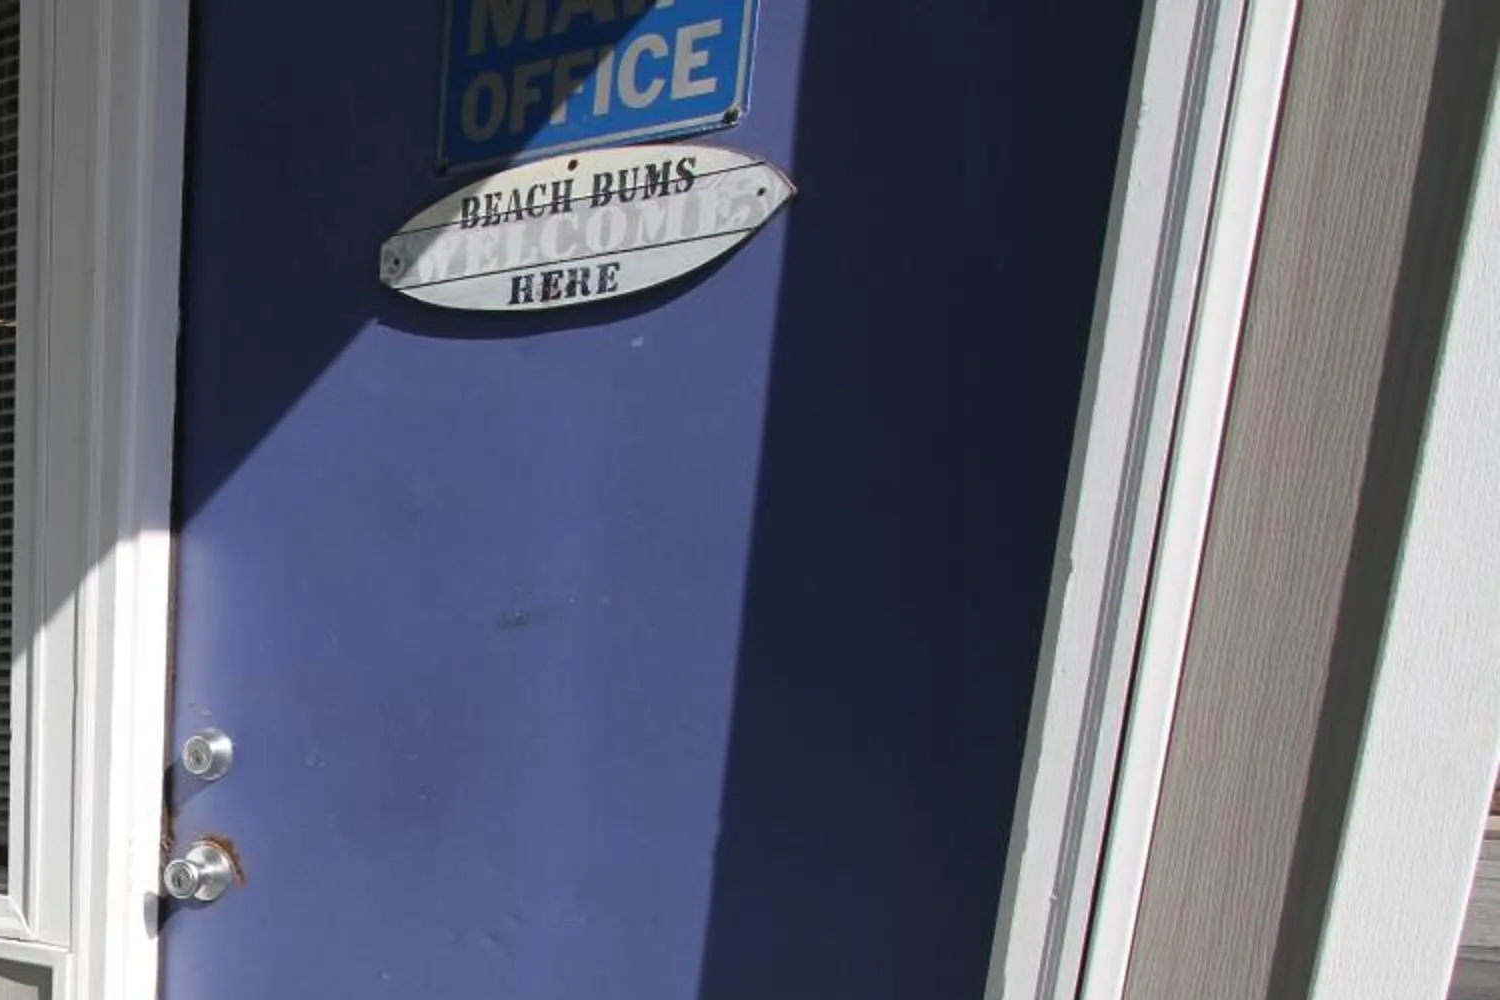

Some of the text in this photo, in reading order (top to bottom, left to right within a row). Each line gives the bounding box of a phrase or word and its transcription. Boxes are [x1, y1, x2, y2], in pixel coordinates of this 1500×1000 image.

[460, 18, 723, 143] OFFICE
[414, 187, 753, 284] WELCOME
[458, 155, 698, 230] BEACH BUMS
[507, 261, 621, 306] HERE
